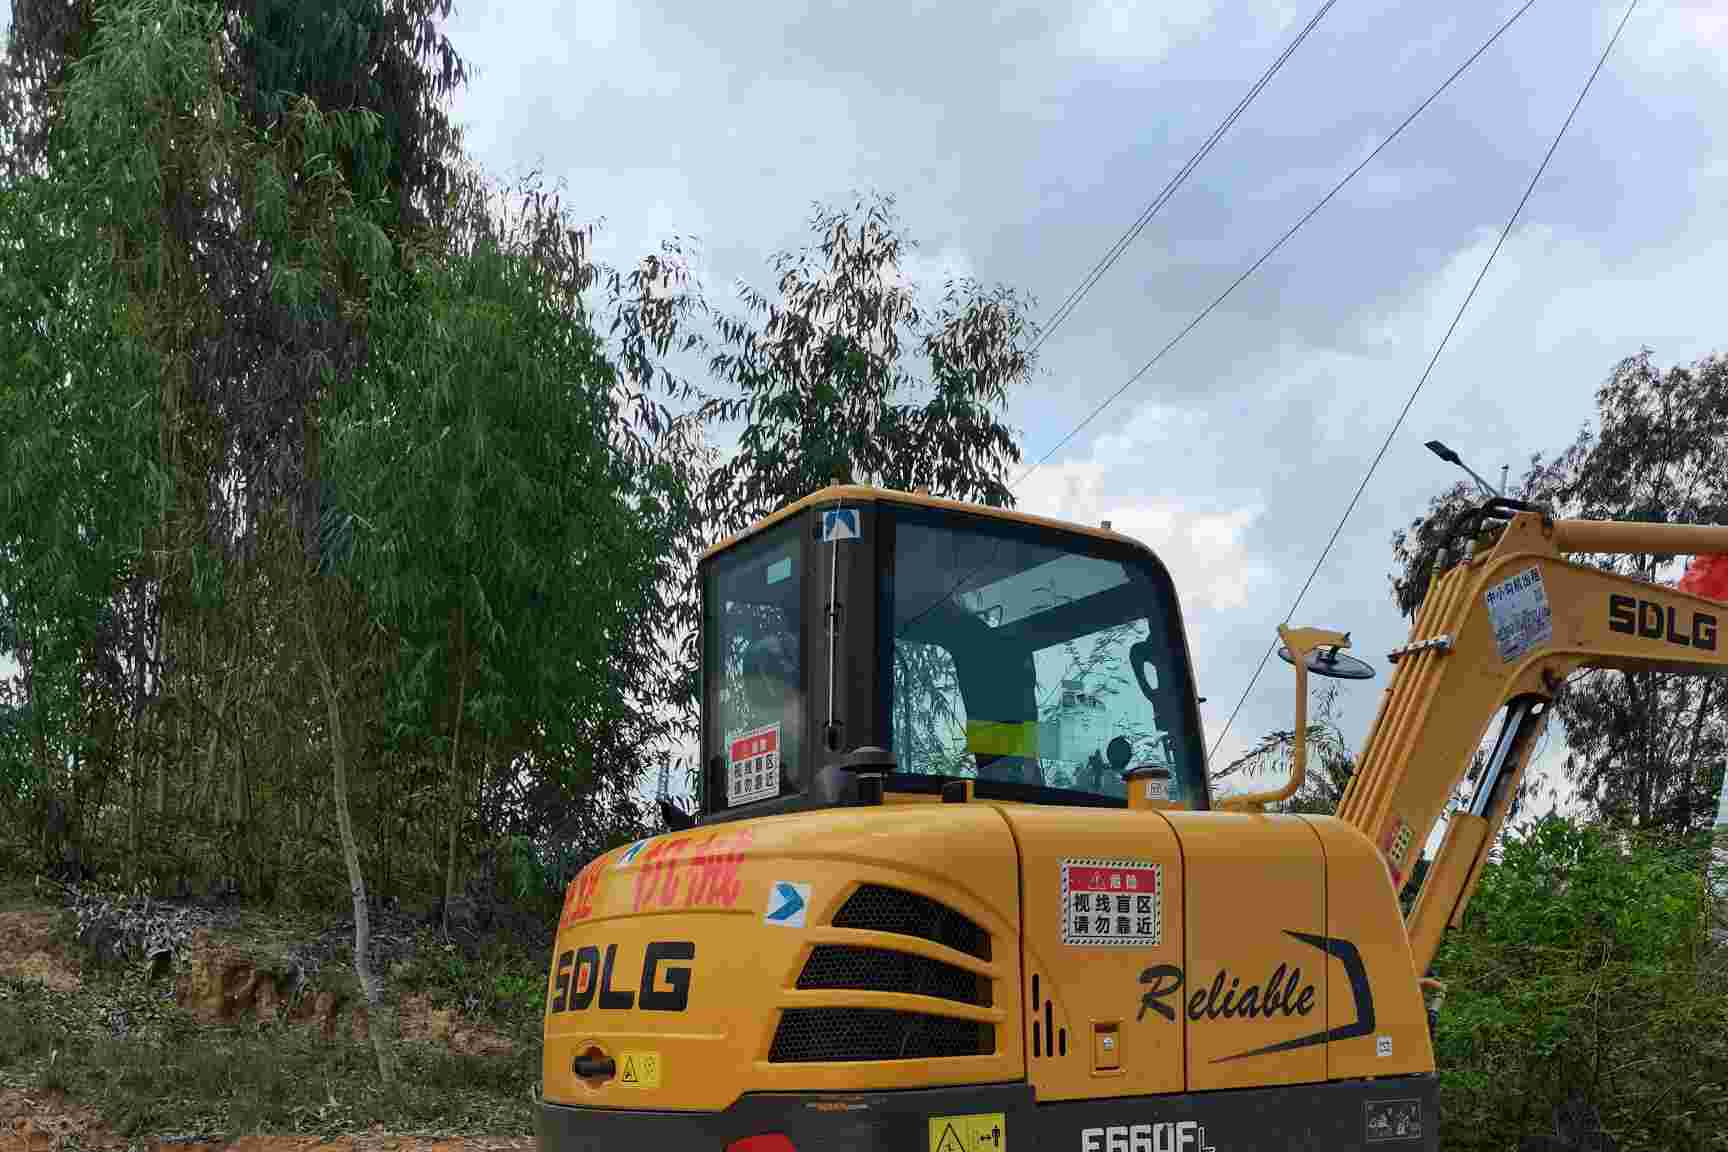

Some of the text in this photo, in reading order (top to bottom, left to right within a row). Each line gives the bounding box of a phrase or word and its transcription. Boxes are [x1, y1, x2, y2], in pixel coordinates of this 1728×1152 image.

[1609, 593, 1717, 651] SDLG
[1073, 893, 1152, 913] 视线盲区
[1073, 915, 1153, 934] 请勿靠近
[551, 942, 696, 1013] SDLG
[1136, 962, 1315, 1022] Reliable
